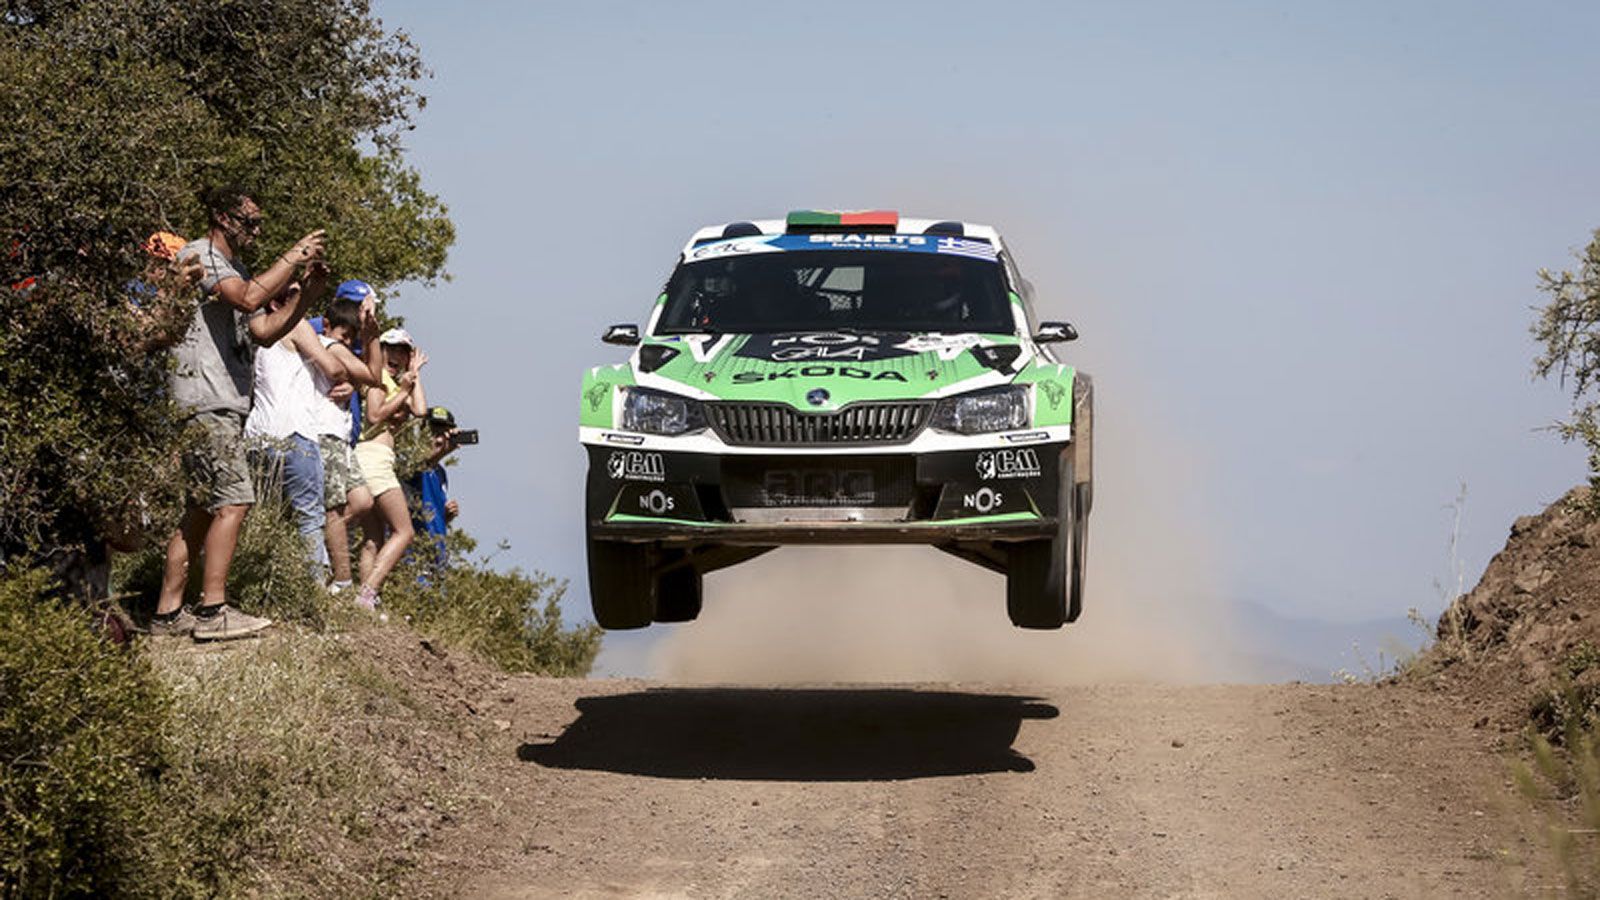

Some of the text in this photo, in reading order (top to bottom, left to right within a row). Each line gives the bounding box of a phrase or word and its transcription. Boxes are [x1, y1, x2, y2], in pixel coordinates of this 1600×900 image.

[809, 234, 926, 245] SEAJETS
[639, 489, 675, 513] NOS
[963, 487, 1002, 512] NOS
